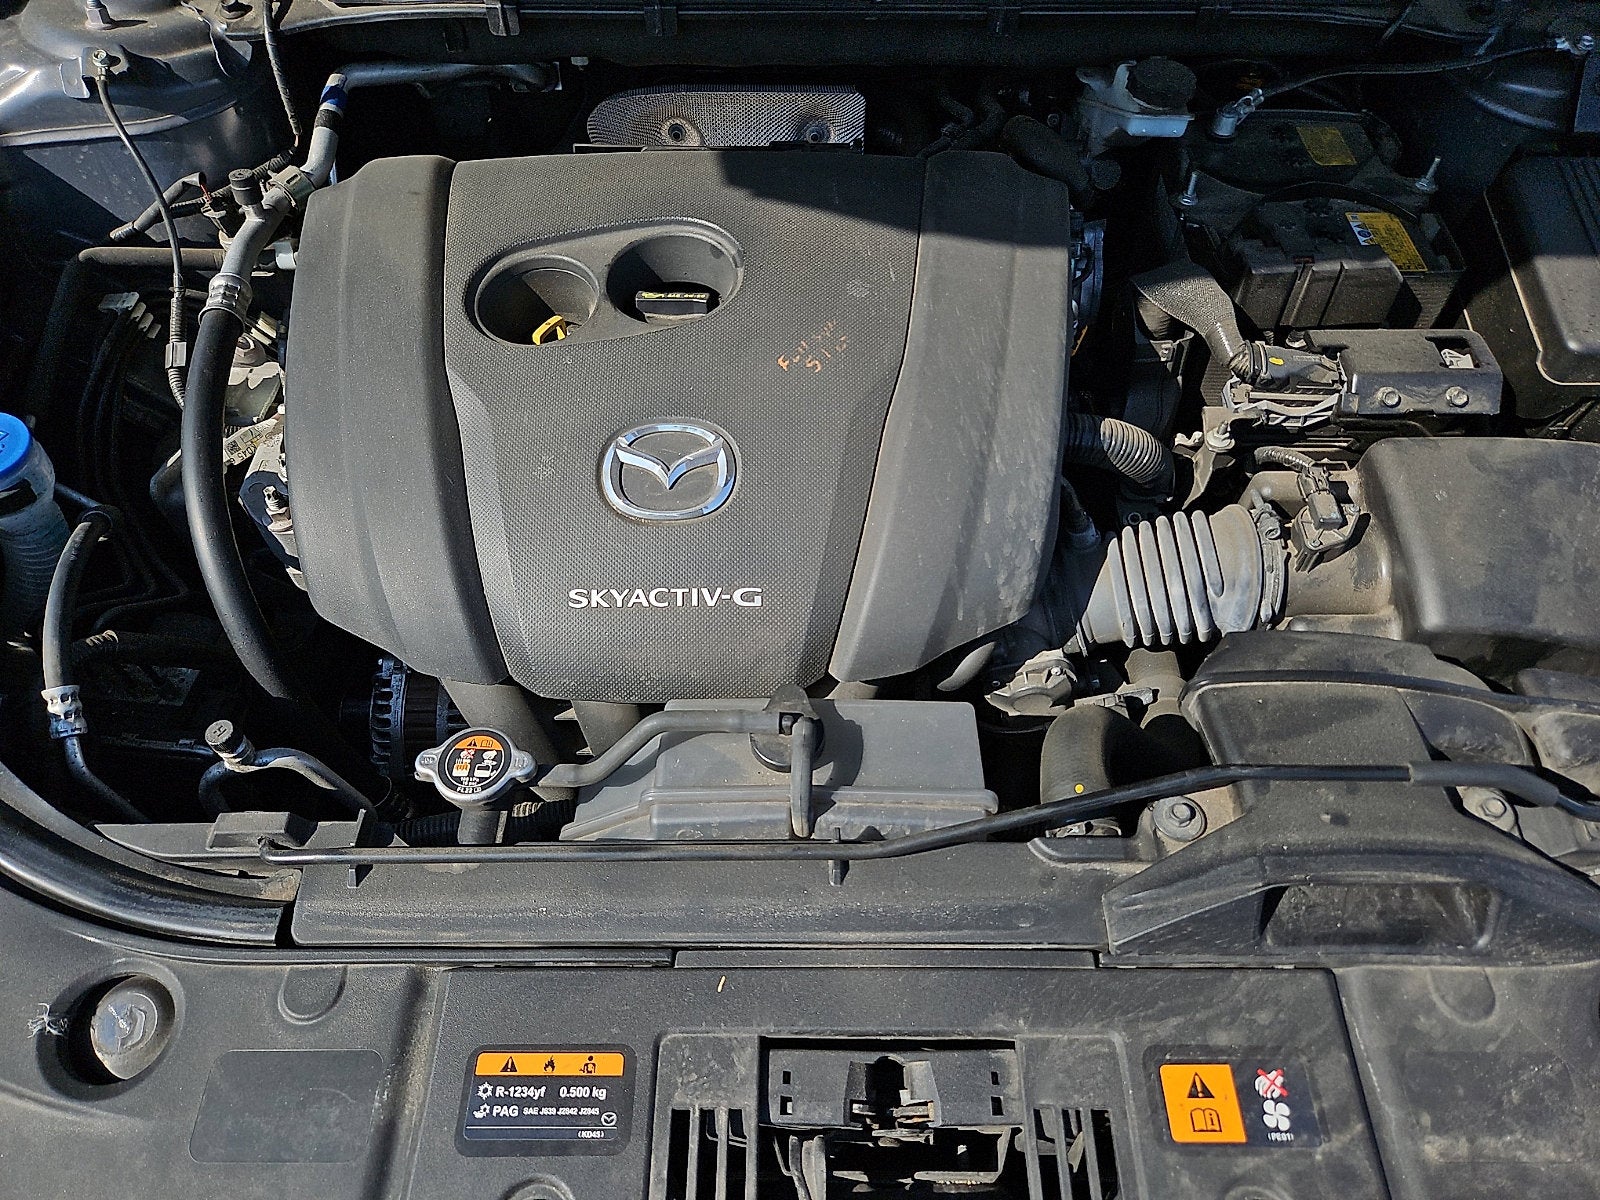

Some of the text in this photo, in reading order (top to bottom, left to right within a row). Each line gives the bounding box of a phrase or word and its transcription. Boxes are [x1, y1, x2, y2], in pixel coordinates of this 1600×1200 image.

[568, 587, 763, 608] SKYACTIV-G
[495, 1086, 607, 1100] R-1234yf 0.500 kg
[492, 1105, 519, 1117] PAG
[523, 1107, 539, 1115] SAE
